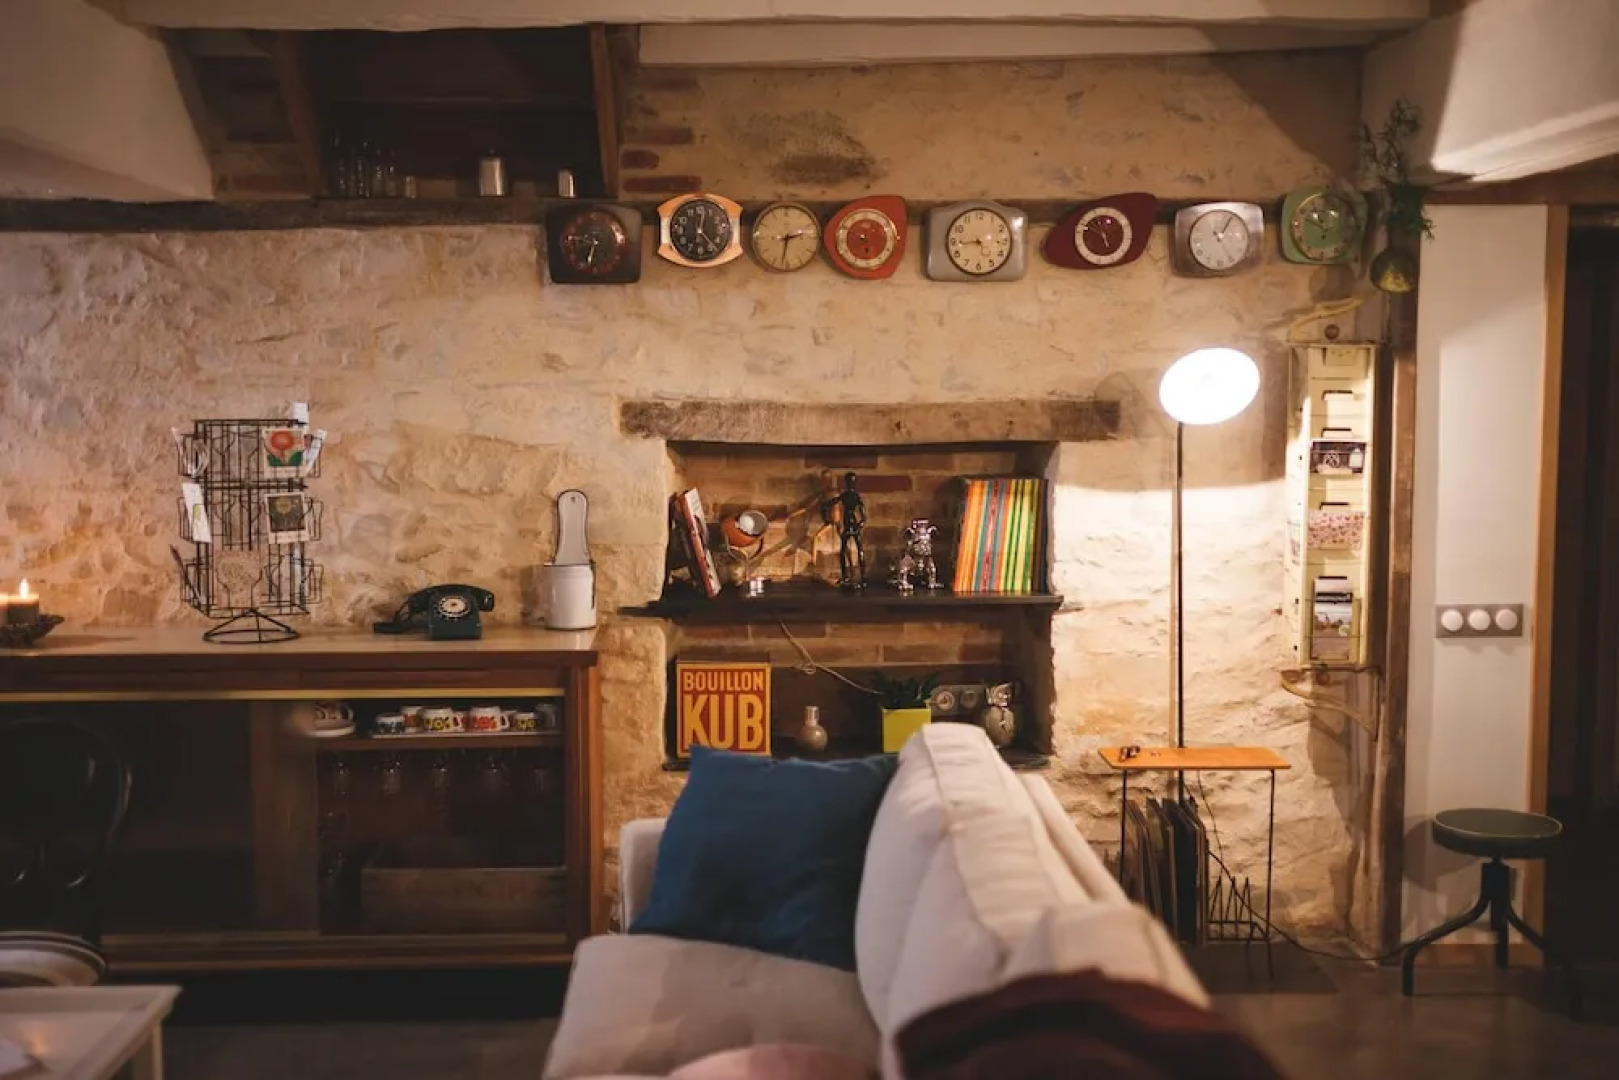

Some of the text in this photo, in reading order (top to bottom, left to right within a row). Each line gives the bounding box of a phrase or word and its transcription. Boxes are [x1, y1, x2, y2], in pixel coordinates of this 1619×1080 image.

[954, 224, 964, 234] 10
[683, 671, 764, 691] BOUILLON
[684, 694, 764, 750] KUB
